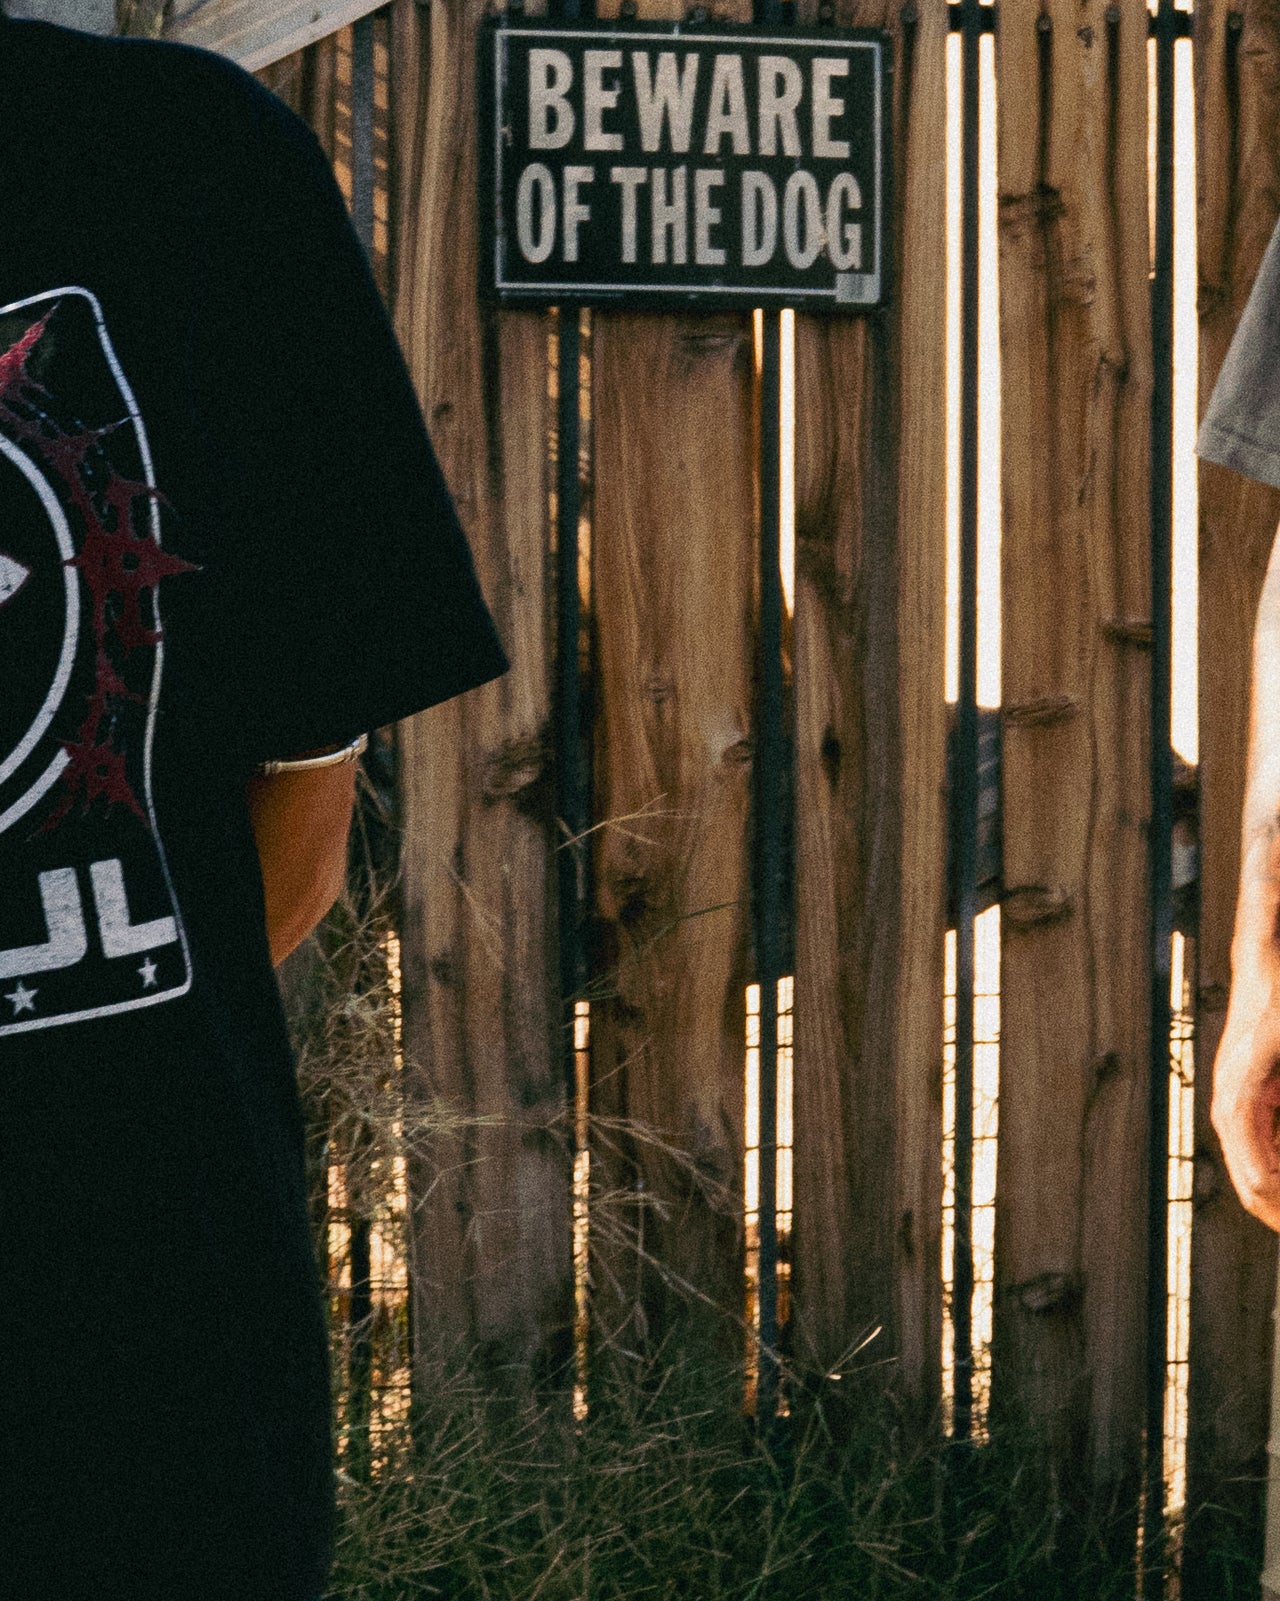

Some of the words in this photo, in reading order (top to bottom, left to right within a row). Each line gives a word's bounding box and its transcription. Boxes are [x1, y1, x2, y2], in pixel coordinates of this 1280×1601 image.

[528, 48, 851, 158] BEWARE
[518, 163, 595, 264] OF
[610, 164, 726, 266] THE
[741, 170, 862, 271] DOG
